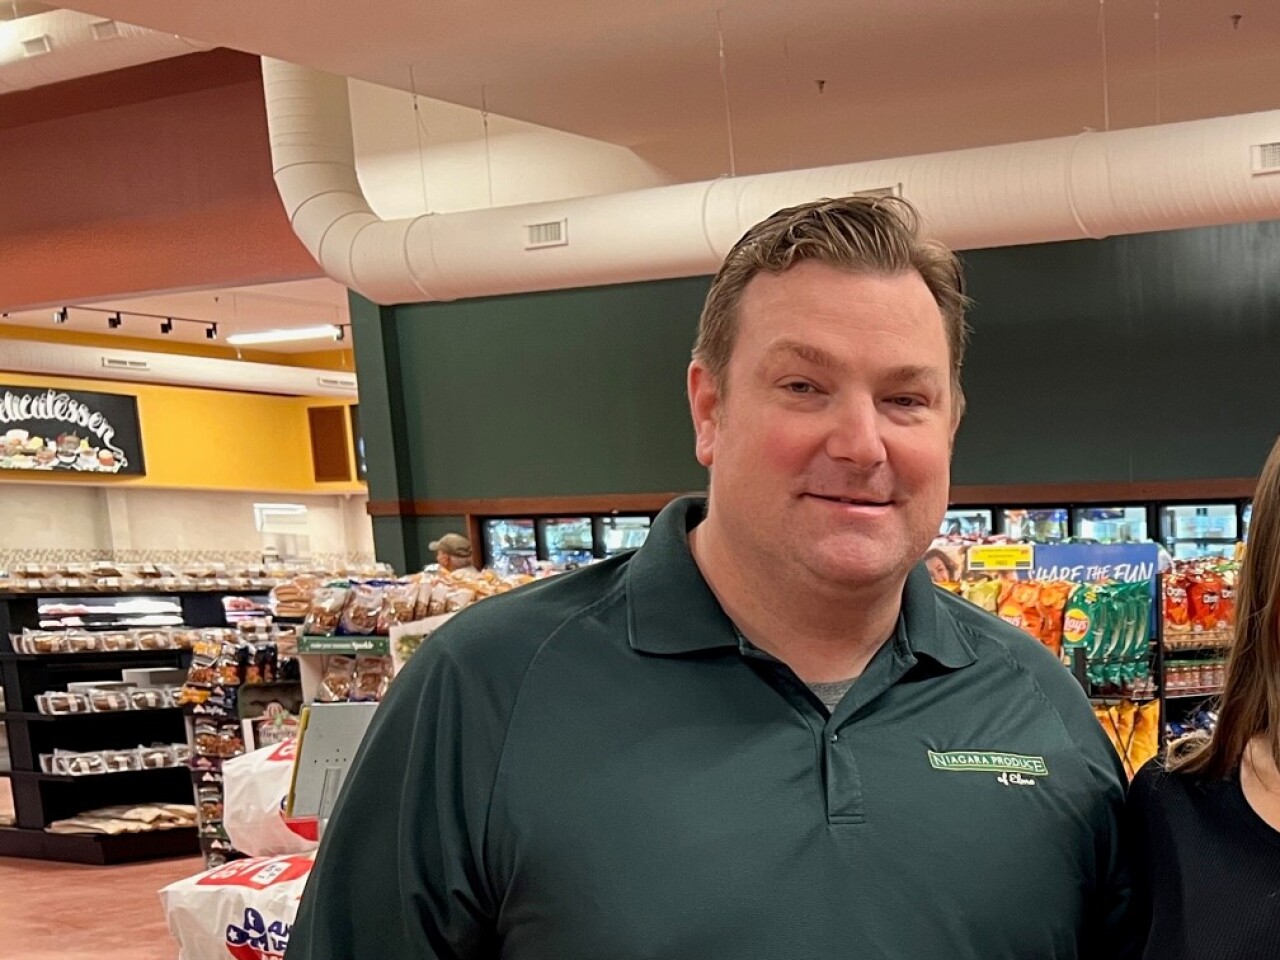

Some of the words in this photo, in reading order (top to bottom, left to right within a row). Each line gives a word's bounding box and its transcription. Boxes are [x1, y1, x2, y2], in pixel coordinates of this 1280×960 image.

[1087, 565, 1110, 580] THE
[1113, 562, 1154, 583] FUN
[932, 754, 989, 767] NIAGARA
[990, 756, 1045, 773] PRODUCE
